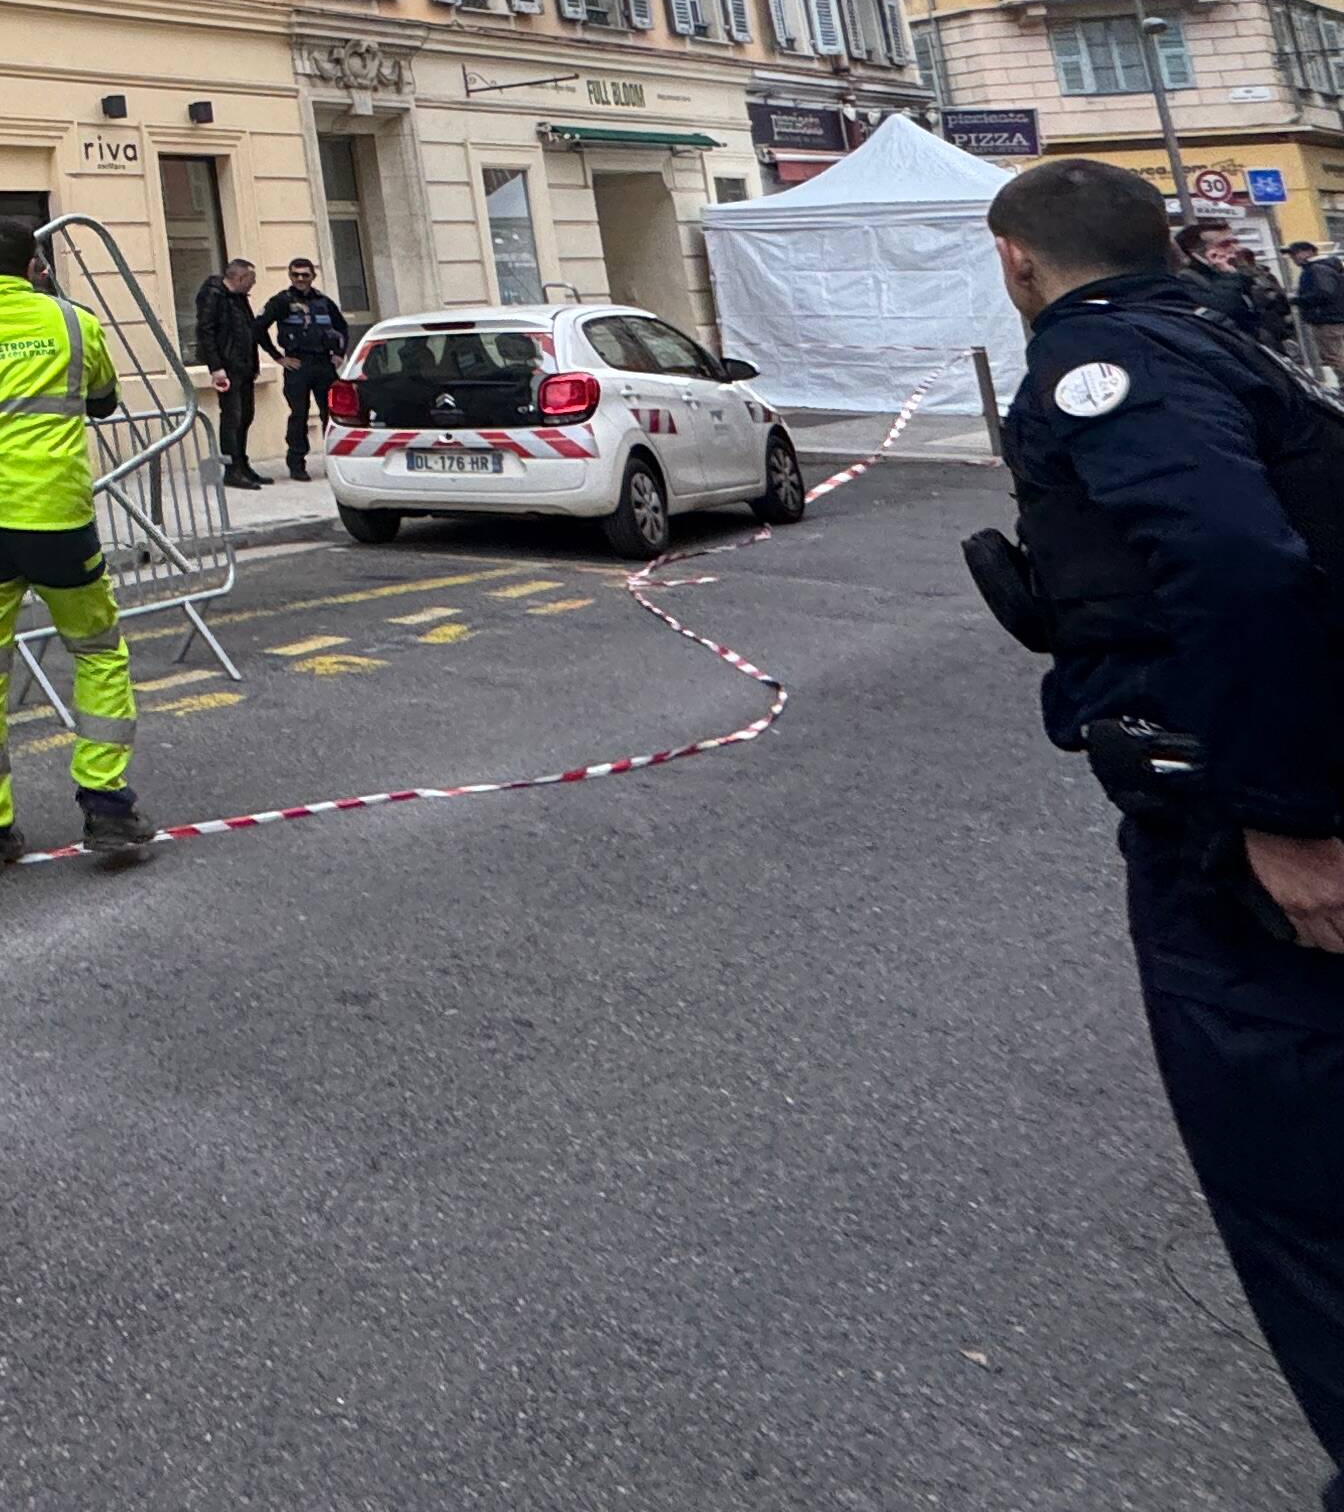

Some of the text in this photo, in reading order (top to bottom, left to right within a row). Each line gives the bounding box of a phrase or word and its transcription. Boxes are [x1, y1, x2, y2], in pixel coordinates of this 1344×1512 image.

[586, 80, 611, 105] FULL
[611, 82, 646, 108] BLOOM
[83, 134, 138, 162] riva
[951, 131, 1030, 147] PIZZA
[1201, 178, 1225, 194] 30
